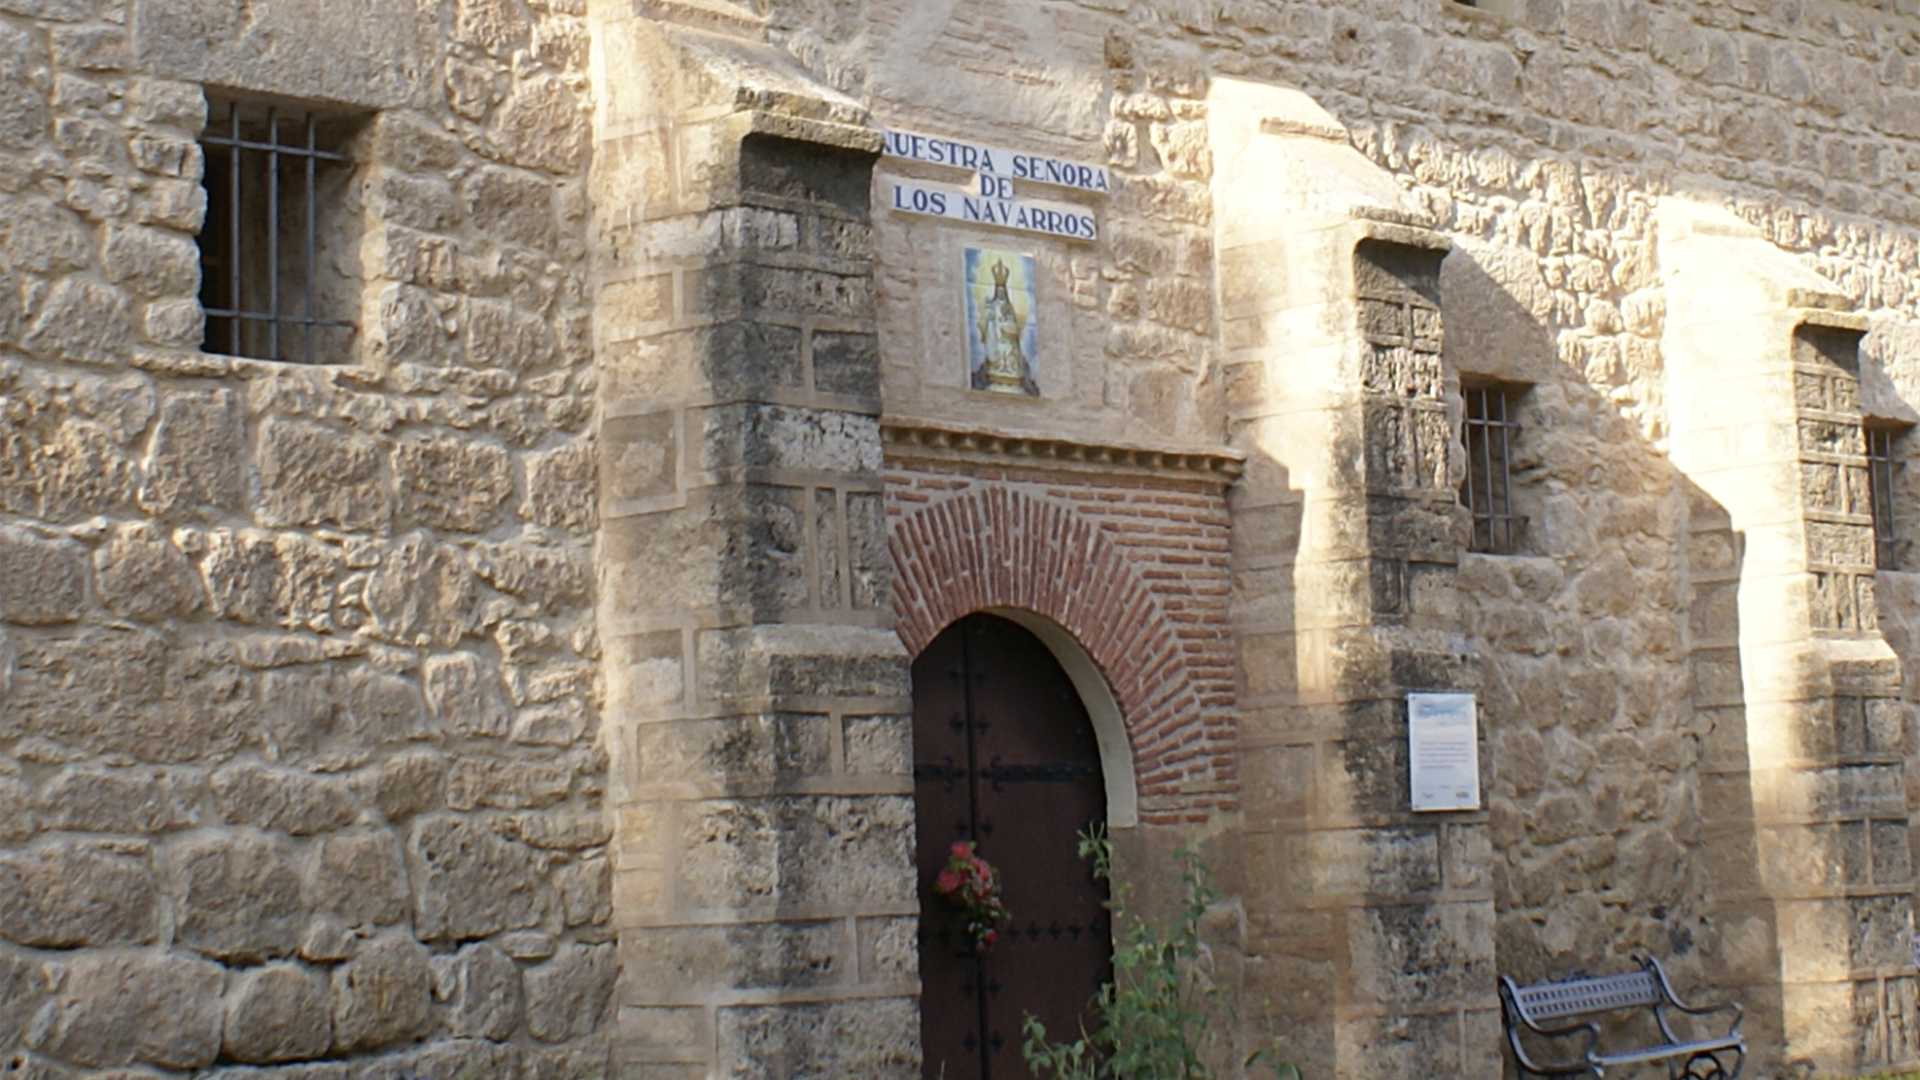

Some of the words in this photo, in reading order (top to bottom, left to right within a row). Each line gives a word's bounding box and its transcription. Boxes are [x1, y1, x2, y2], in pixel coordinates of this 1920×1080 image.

[980, 174, 1012, 198] DE
[1013, 155, 1108, 191] SEÑORA
[895, 186, 946, 215] LOS
[964, 199, 1094, 238] NAVARROS
